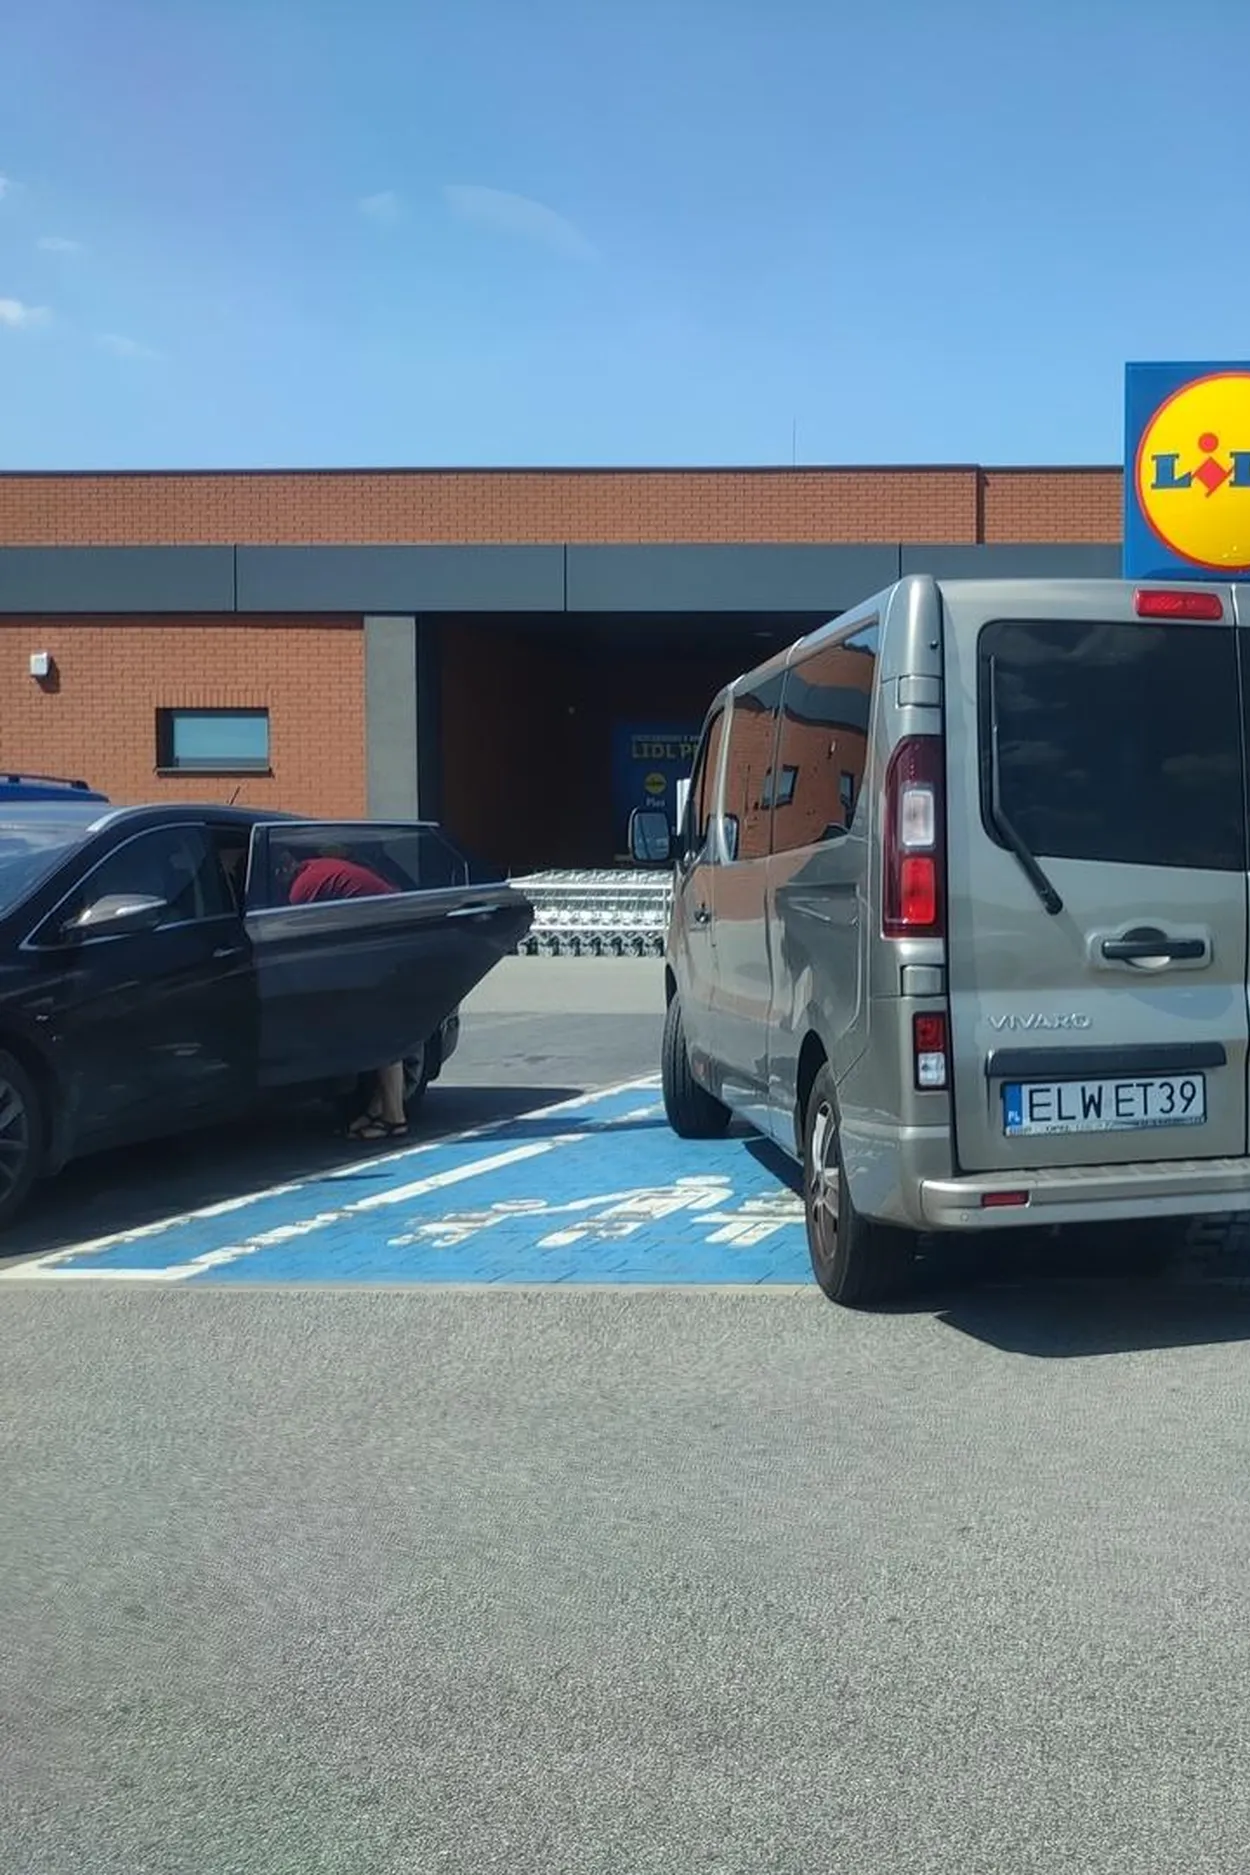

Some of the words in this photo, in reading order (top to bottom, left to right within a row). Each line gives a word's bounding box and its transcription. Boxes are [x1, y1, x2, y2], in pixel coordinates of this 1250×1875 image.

[631, 742, 677, 759] LIDL
[988, 1012, 1093, 1031] VIVARO
[1028, 1085, 1103, 1122] ELW
[1115, 1080, 1197, 1117] ET39
